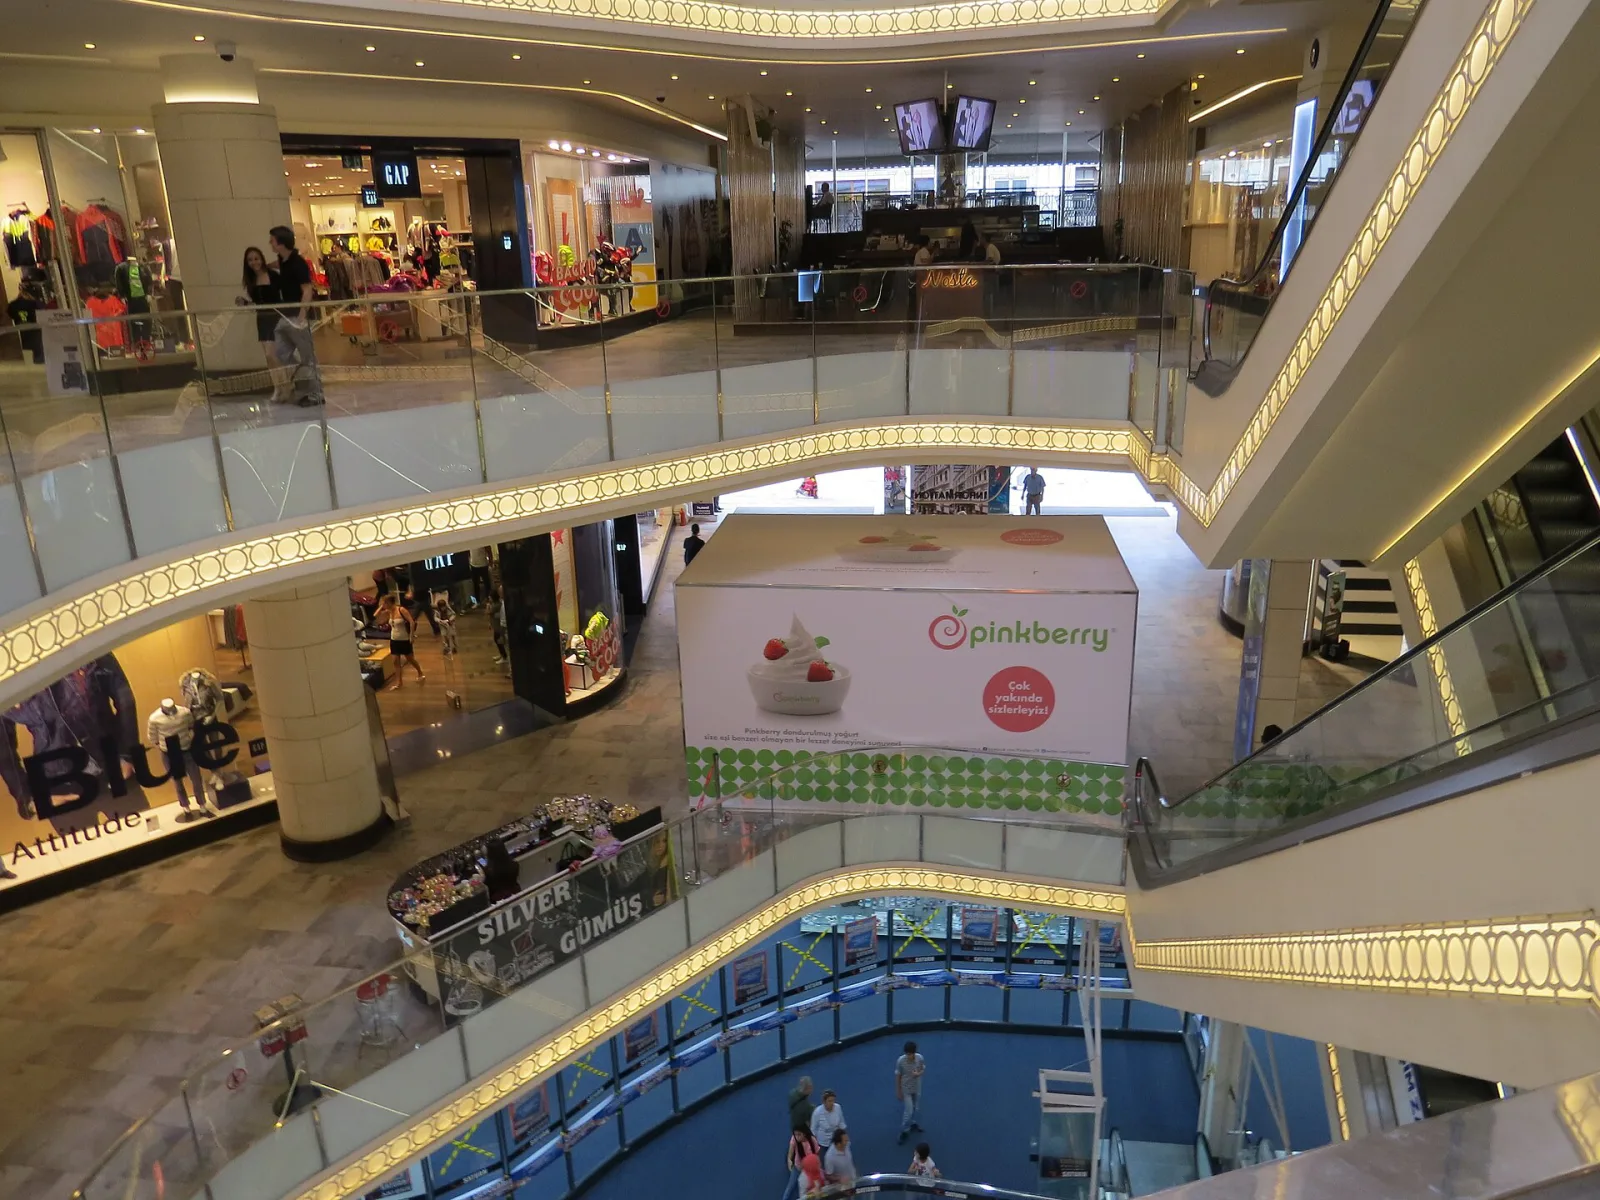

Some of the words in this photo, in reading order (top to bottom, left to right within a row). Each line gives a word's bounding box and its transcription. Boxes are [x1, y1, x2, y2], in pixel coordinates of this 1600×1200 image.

[384, 164, 410, 185] GAP
[556, 258, 586, 281] BACK
[921, 267, 979, 289] Nosta
[969, 620, 1109, 653] pinkberry
[1008, 680, 1031, 693] Çok
[994, 693, 1043, 705] yakında
[988, 705, 1049, 716] sizlerleyiz!
[744, 727, 781, 736] Pinkberry
[782, 729, 832, 738] dondurulmuş
[833, 730, 859, 738] yoğurt
[760, 736, 794, 744] olmayan
[795, 736, 806, 744] bir
[23, 721, 241, 821] Blue
[477, 879, 573, 946] SILVER
[559, 892, 644, 954] GÜMÜŞ
